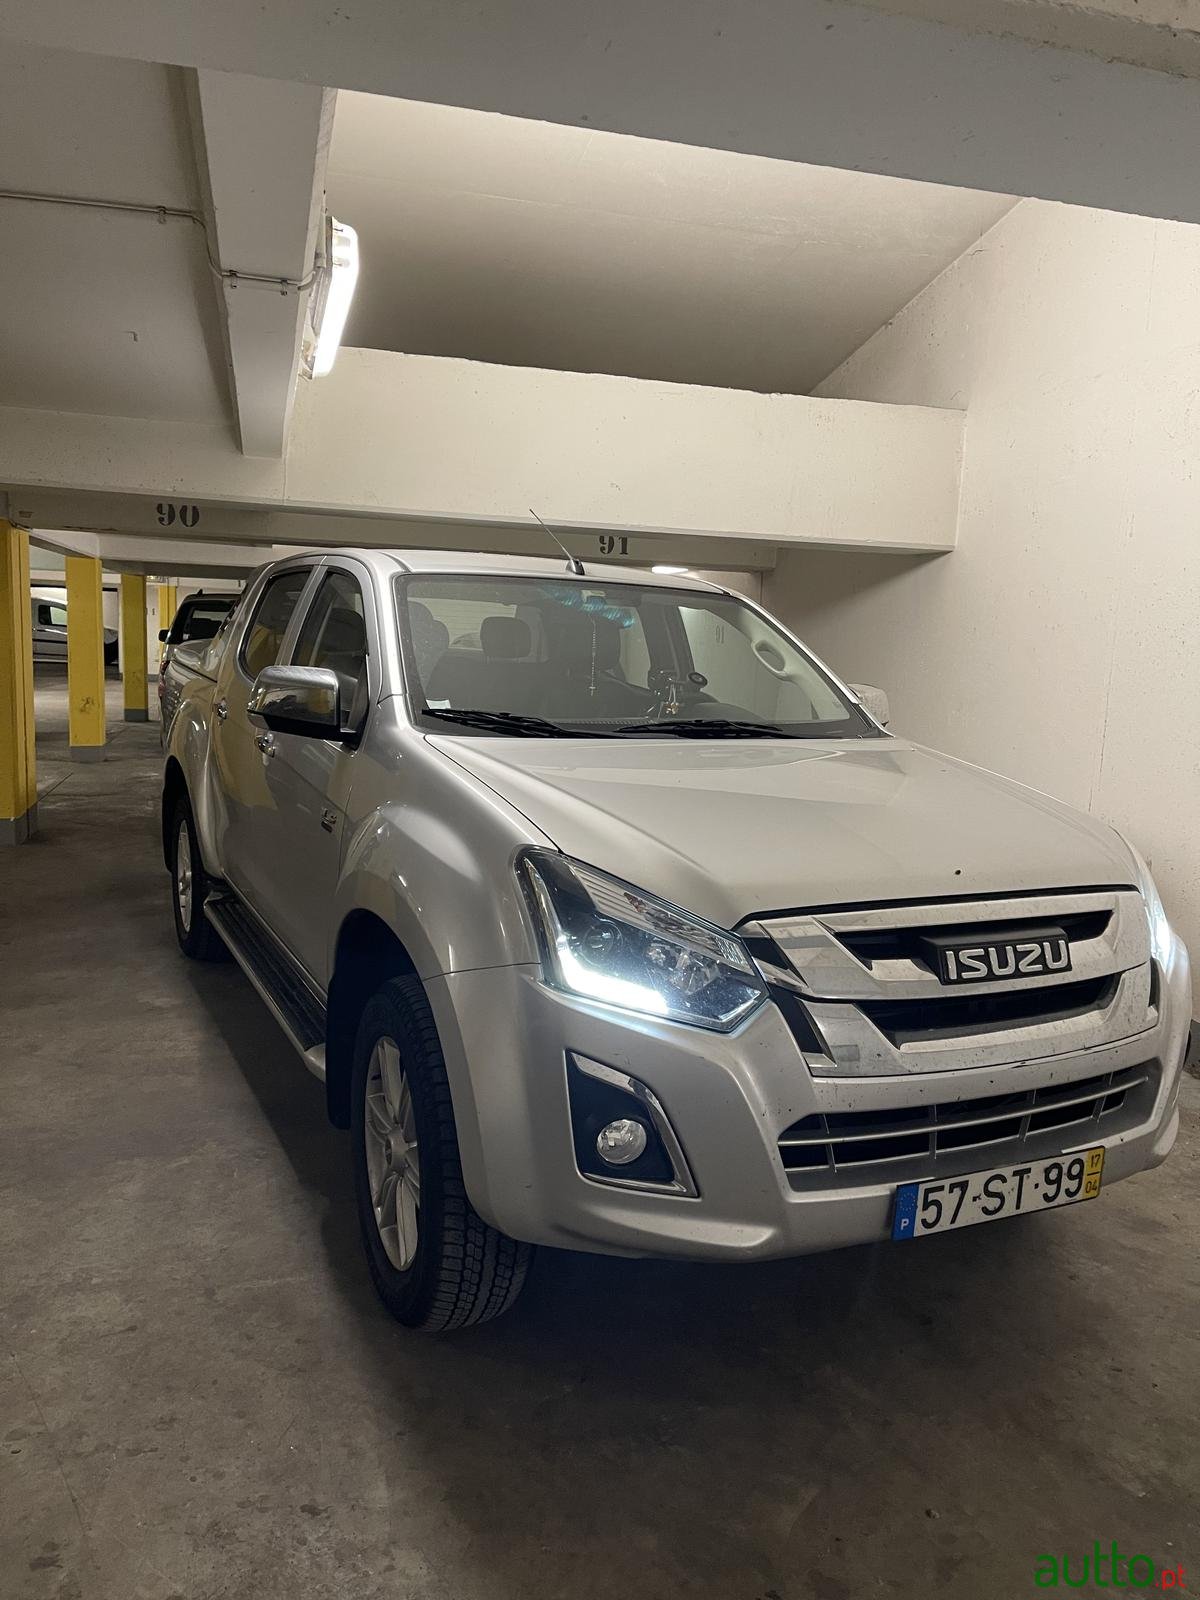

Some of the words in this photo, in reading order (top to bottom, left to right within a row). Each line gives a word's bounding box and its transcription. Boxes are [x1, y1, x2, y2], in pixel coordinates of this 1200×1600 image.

[157, 503, 200, 528] 90
[599, 535, 629, 555] 91
[945, 940, 1069, 980] ISUZU
[1090, 1153, 1101, 1169] 17
[1085, 1179, 1098, 1194] 04
[900, 1218, 910, 1231] P
